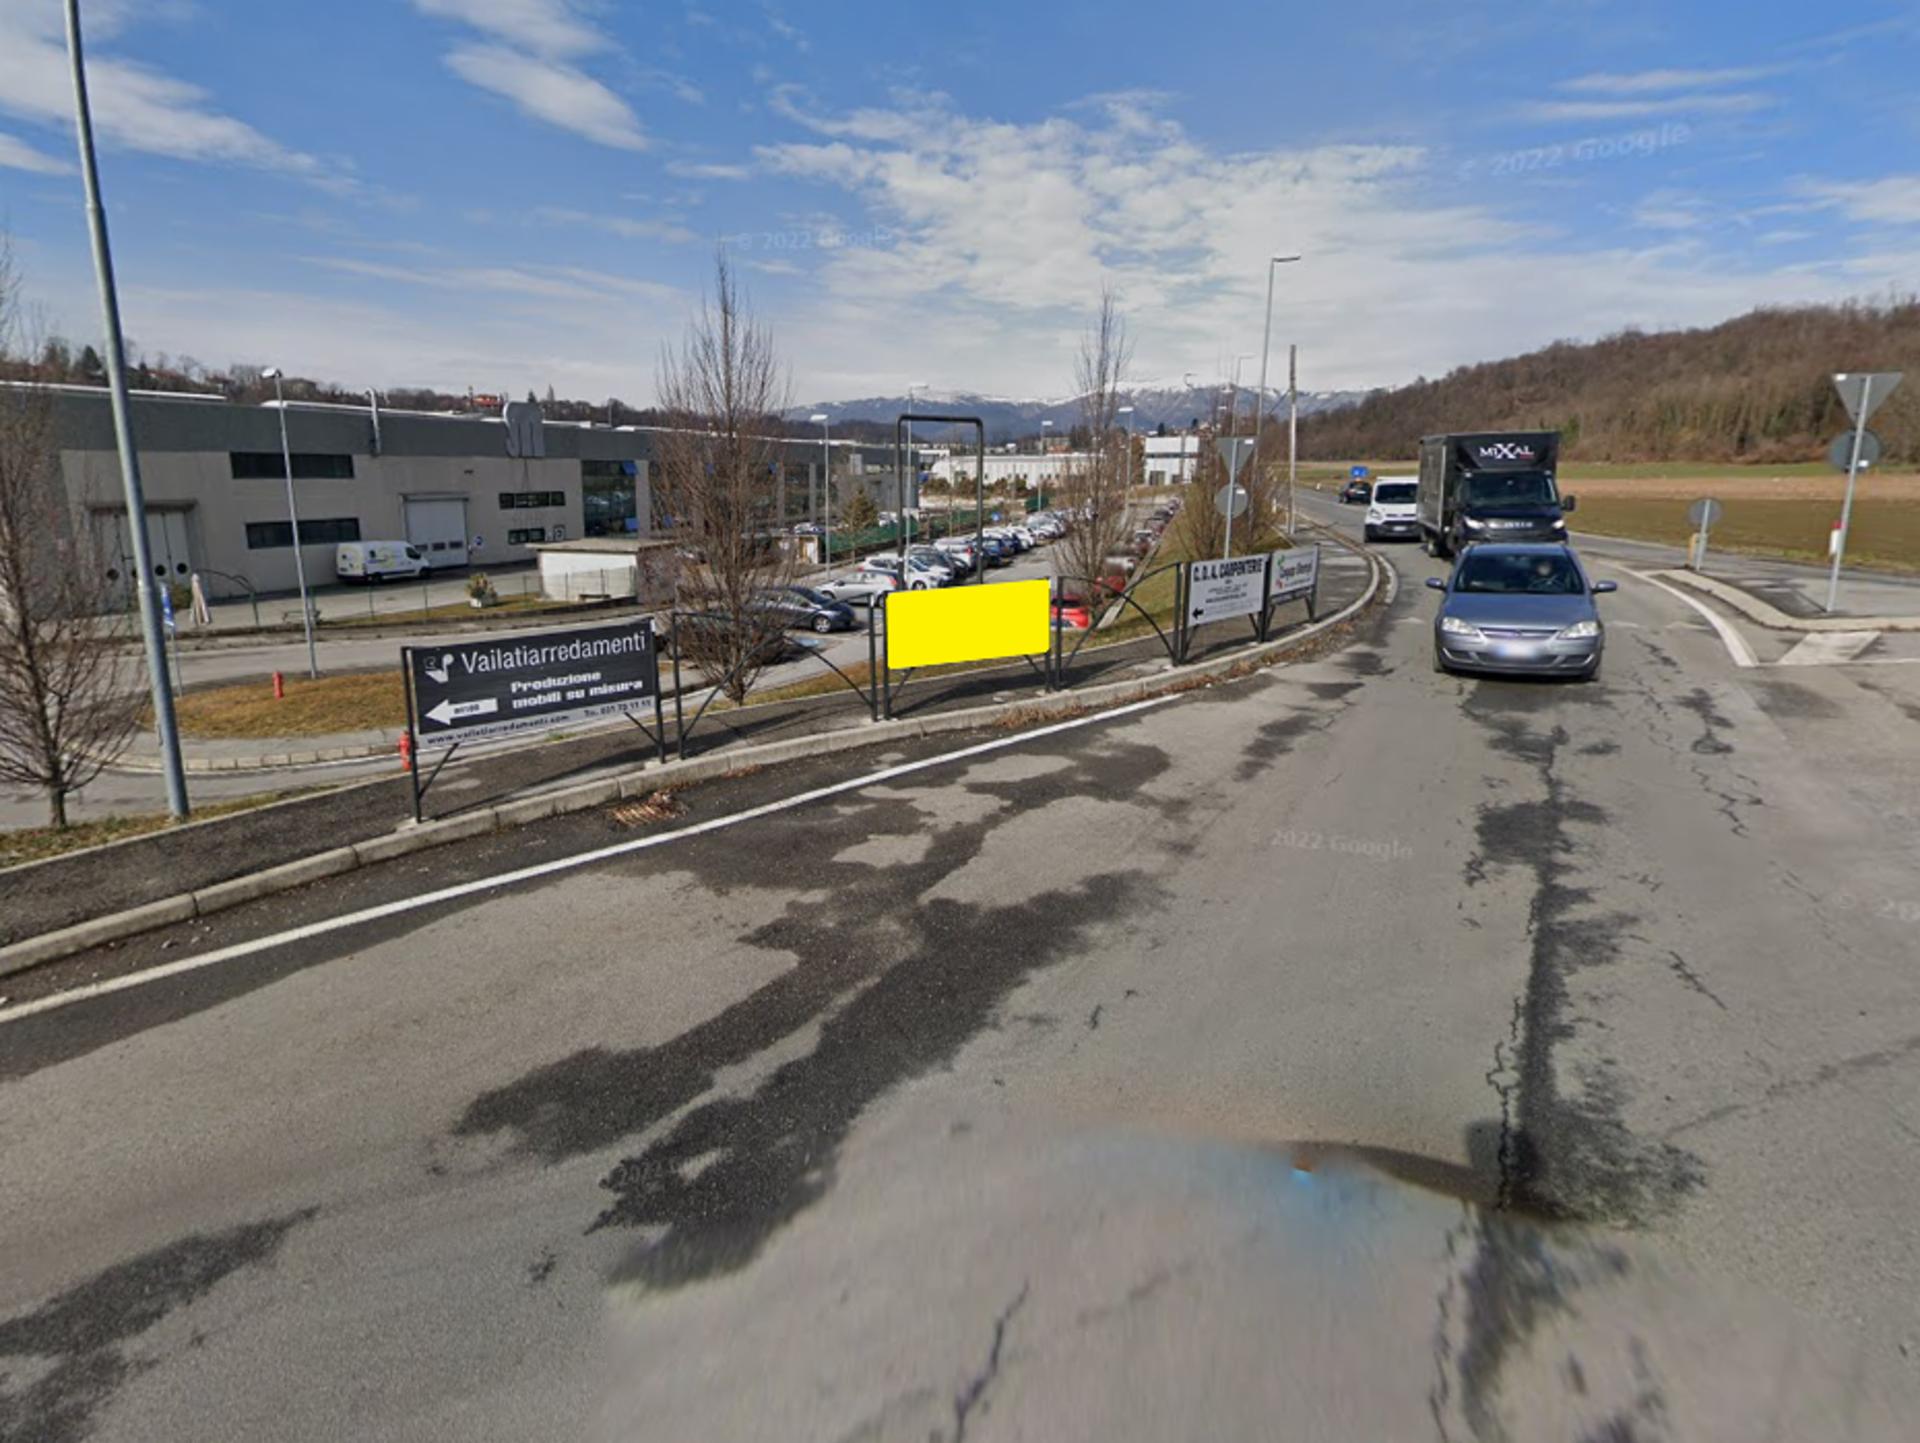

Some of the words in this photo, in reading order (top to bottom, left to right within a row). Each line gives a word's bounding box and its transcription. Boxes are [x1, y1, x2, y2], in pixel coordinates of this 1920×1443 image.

[460, 630, 646, 674] Vailatiarredamenti
[510, 670, 602, 693] Produzione
[512, 691, 562, 709] mobili
[565, 688, 585, 701] su
[589, 680, 644, 697] misura
